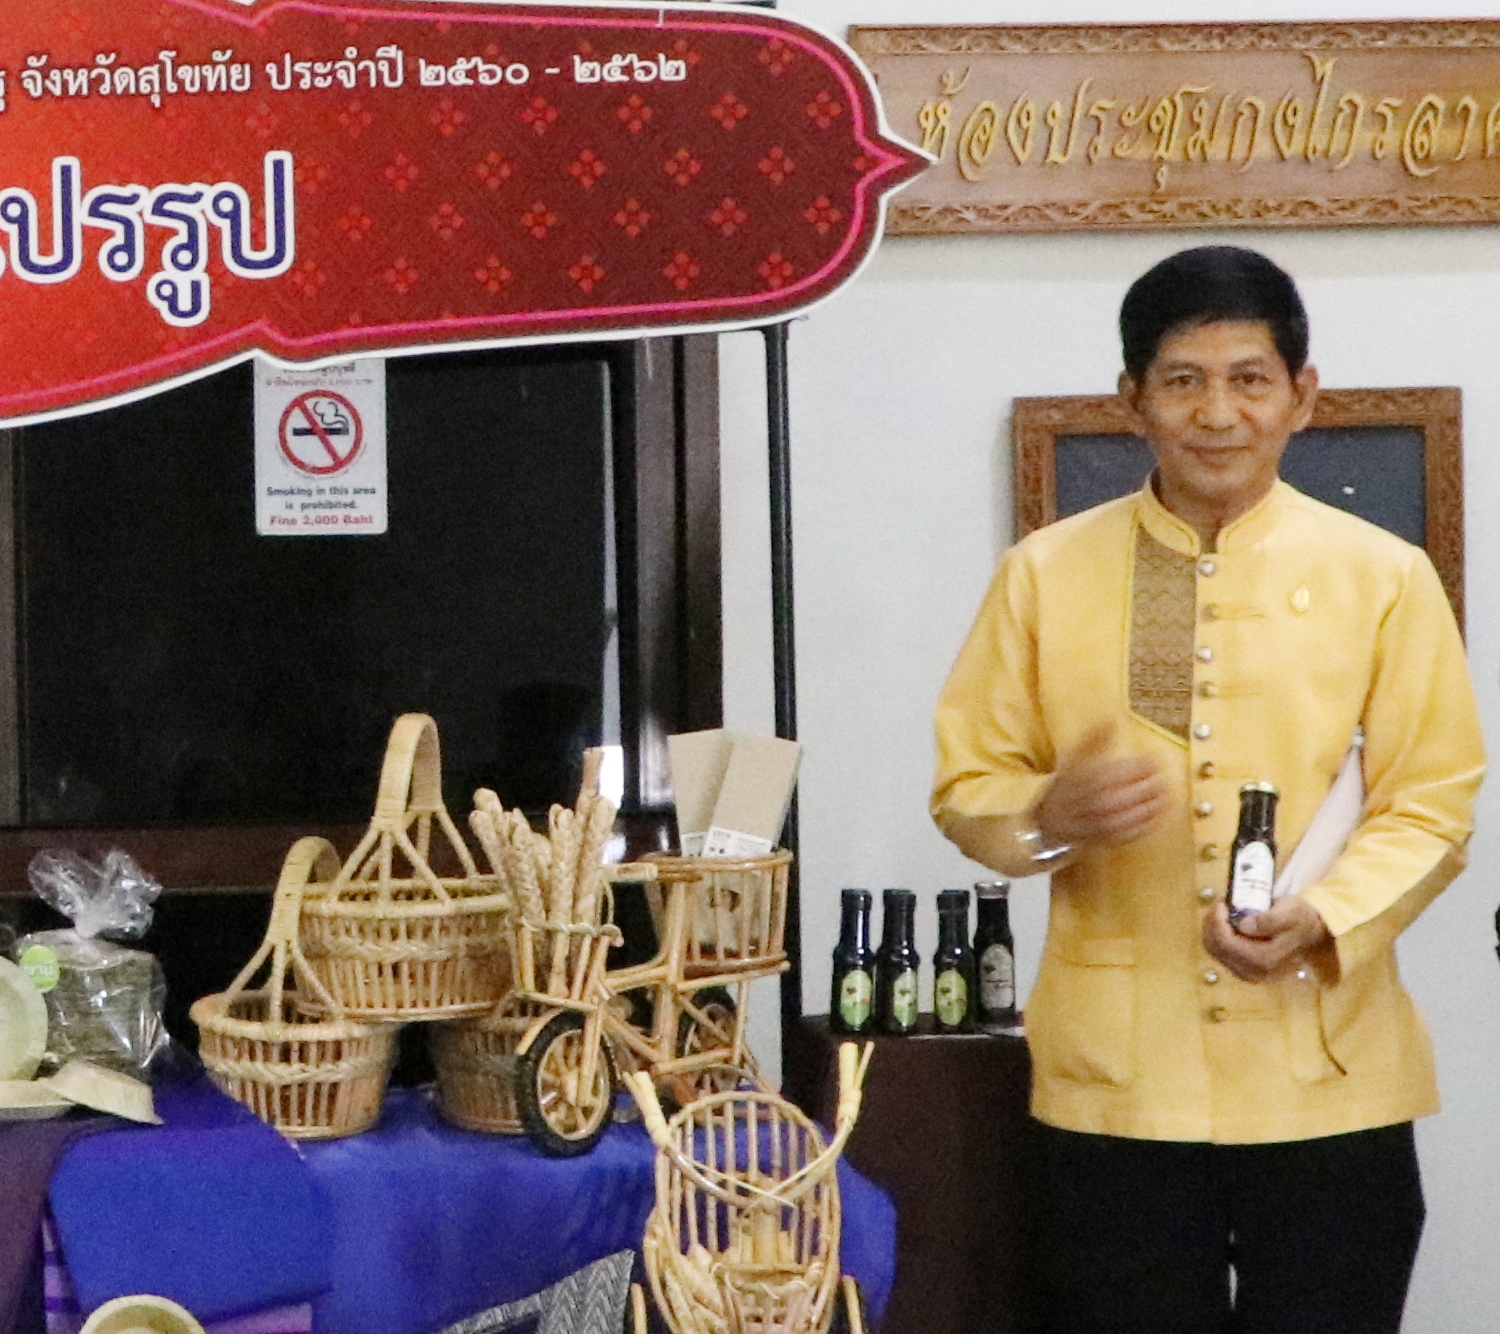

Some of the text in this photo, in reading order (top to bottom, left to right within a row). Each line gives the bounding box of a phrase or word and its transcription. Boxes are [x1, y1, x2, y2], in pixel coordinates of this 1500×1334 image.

[20, 49, 252, 108] จังหวัดสุโขทัย
[265, 44, 405, 92] ประจำปี
[418, 56, 531, 87] ๒๕๖๐
[572, 52, 688, 84] ๒๕๖๒
[266, 486, 313, 497] Smoking
[329, 486, 349, 496] this
[352, 487, 376, 496] area
[269, 515, 299, 526] Fine
